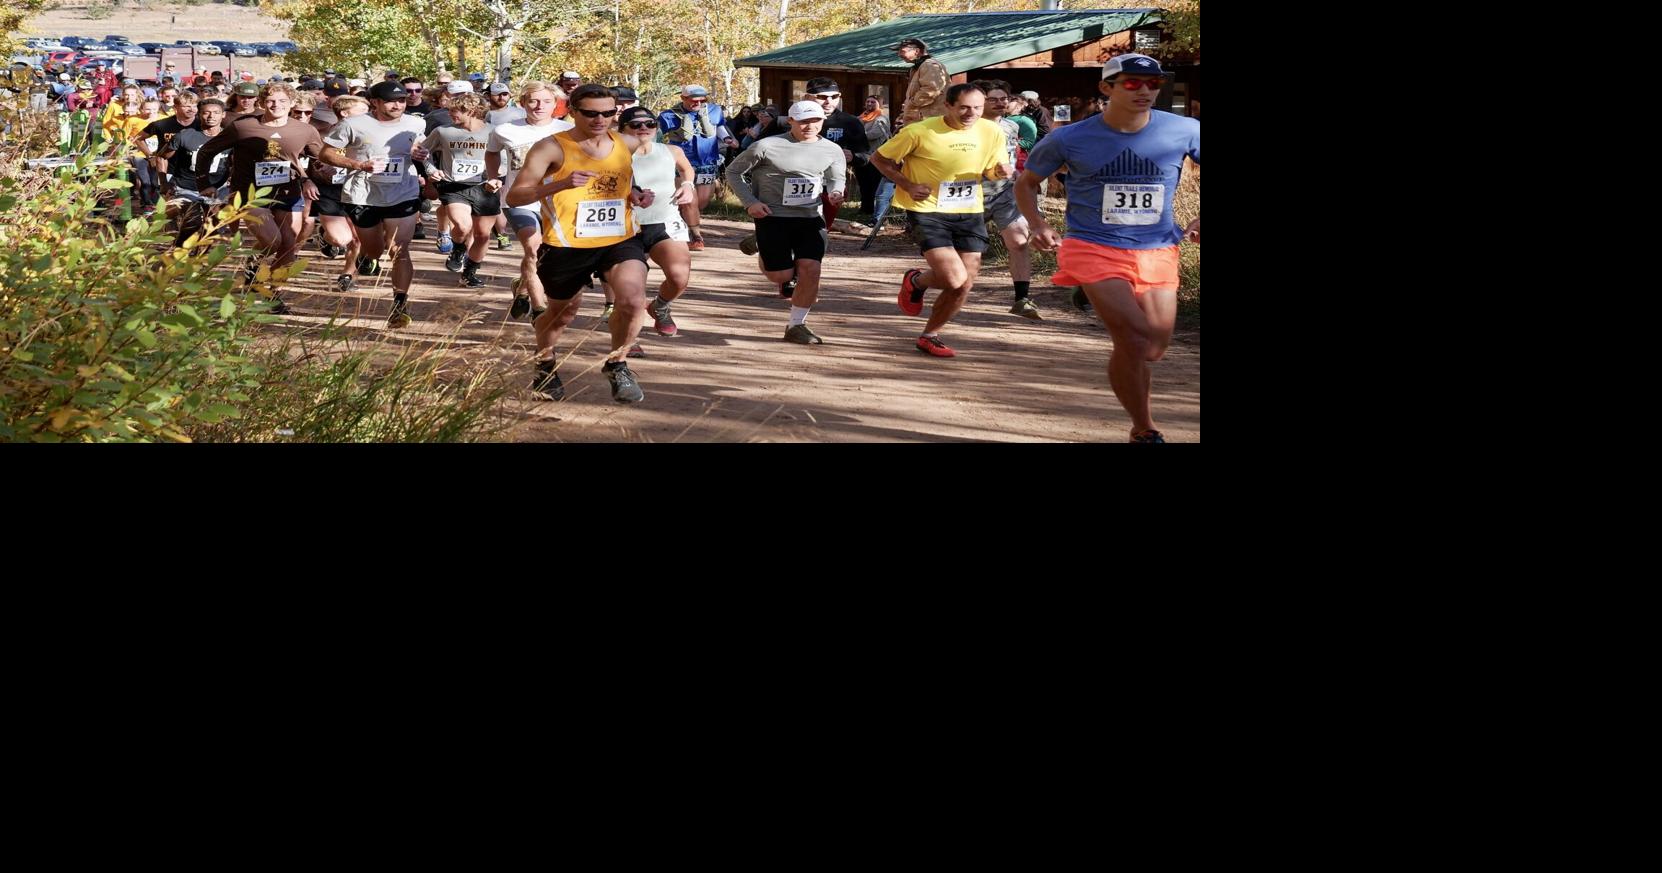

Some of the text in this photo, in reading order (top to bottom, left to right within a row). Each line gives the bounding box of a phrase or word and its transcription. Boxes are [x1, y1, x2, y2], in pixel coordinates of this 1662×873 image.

[262, 166, 284, 175] 274
[457, 164, 478, 174] 279
[792, 183, 815, 194] 312
[946, 186, 973, 198] 313
[1114, 192, 1152, 208] 318
[586, 208, 616, 222] 269
